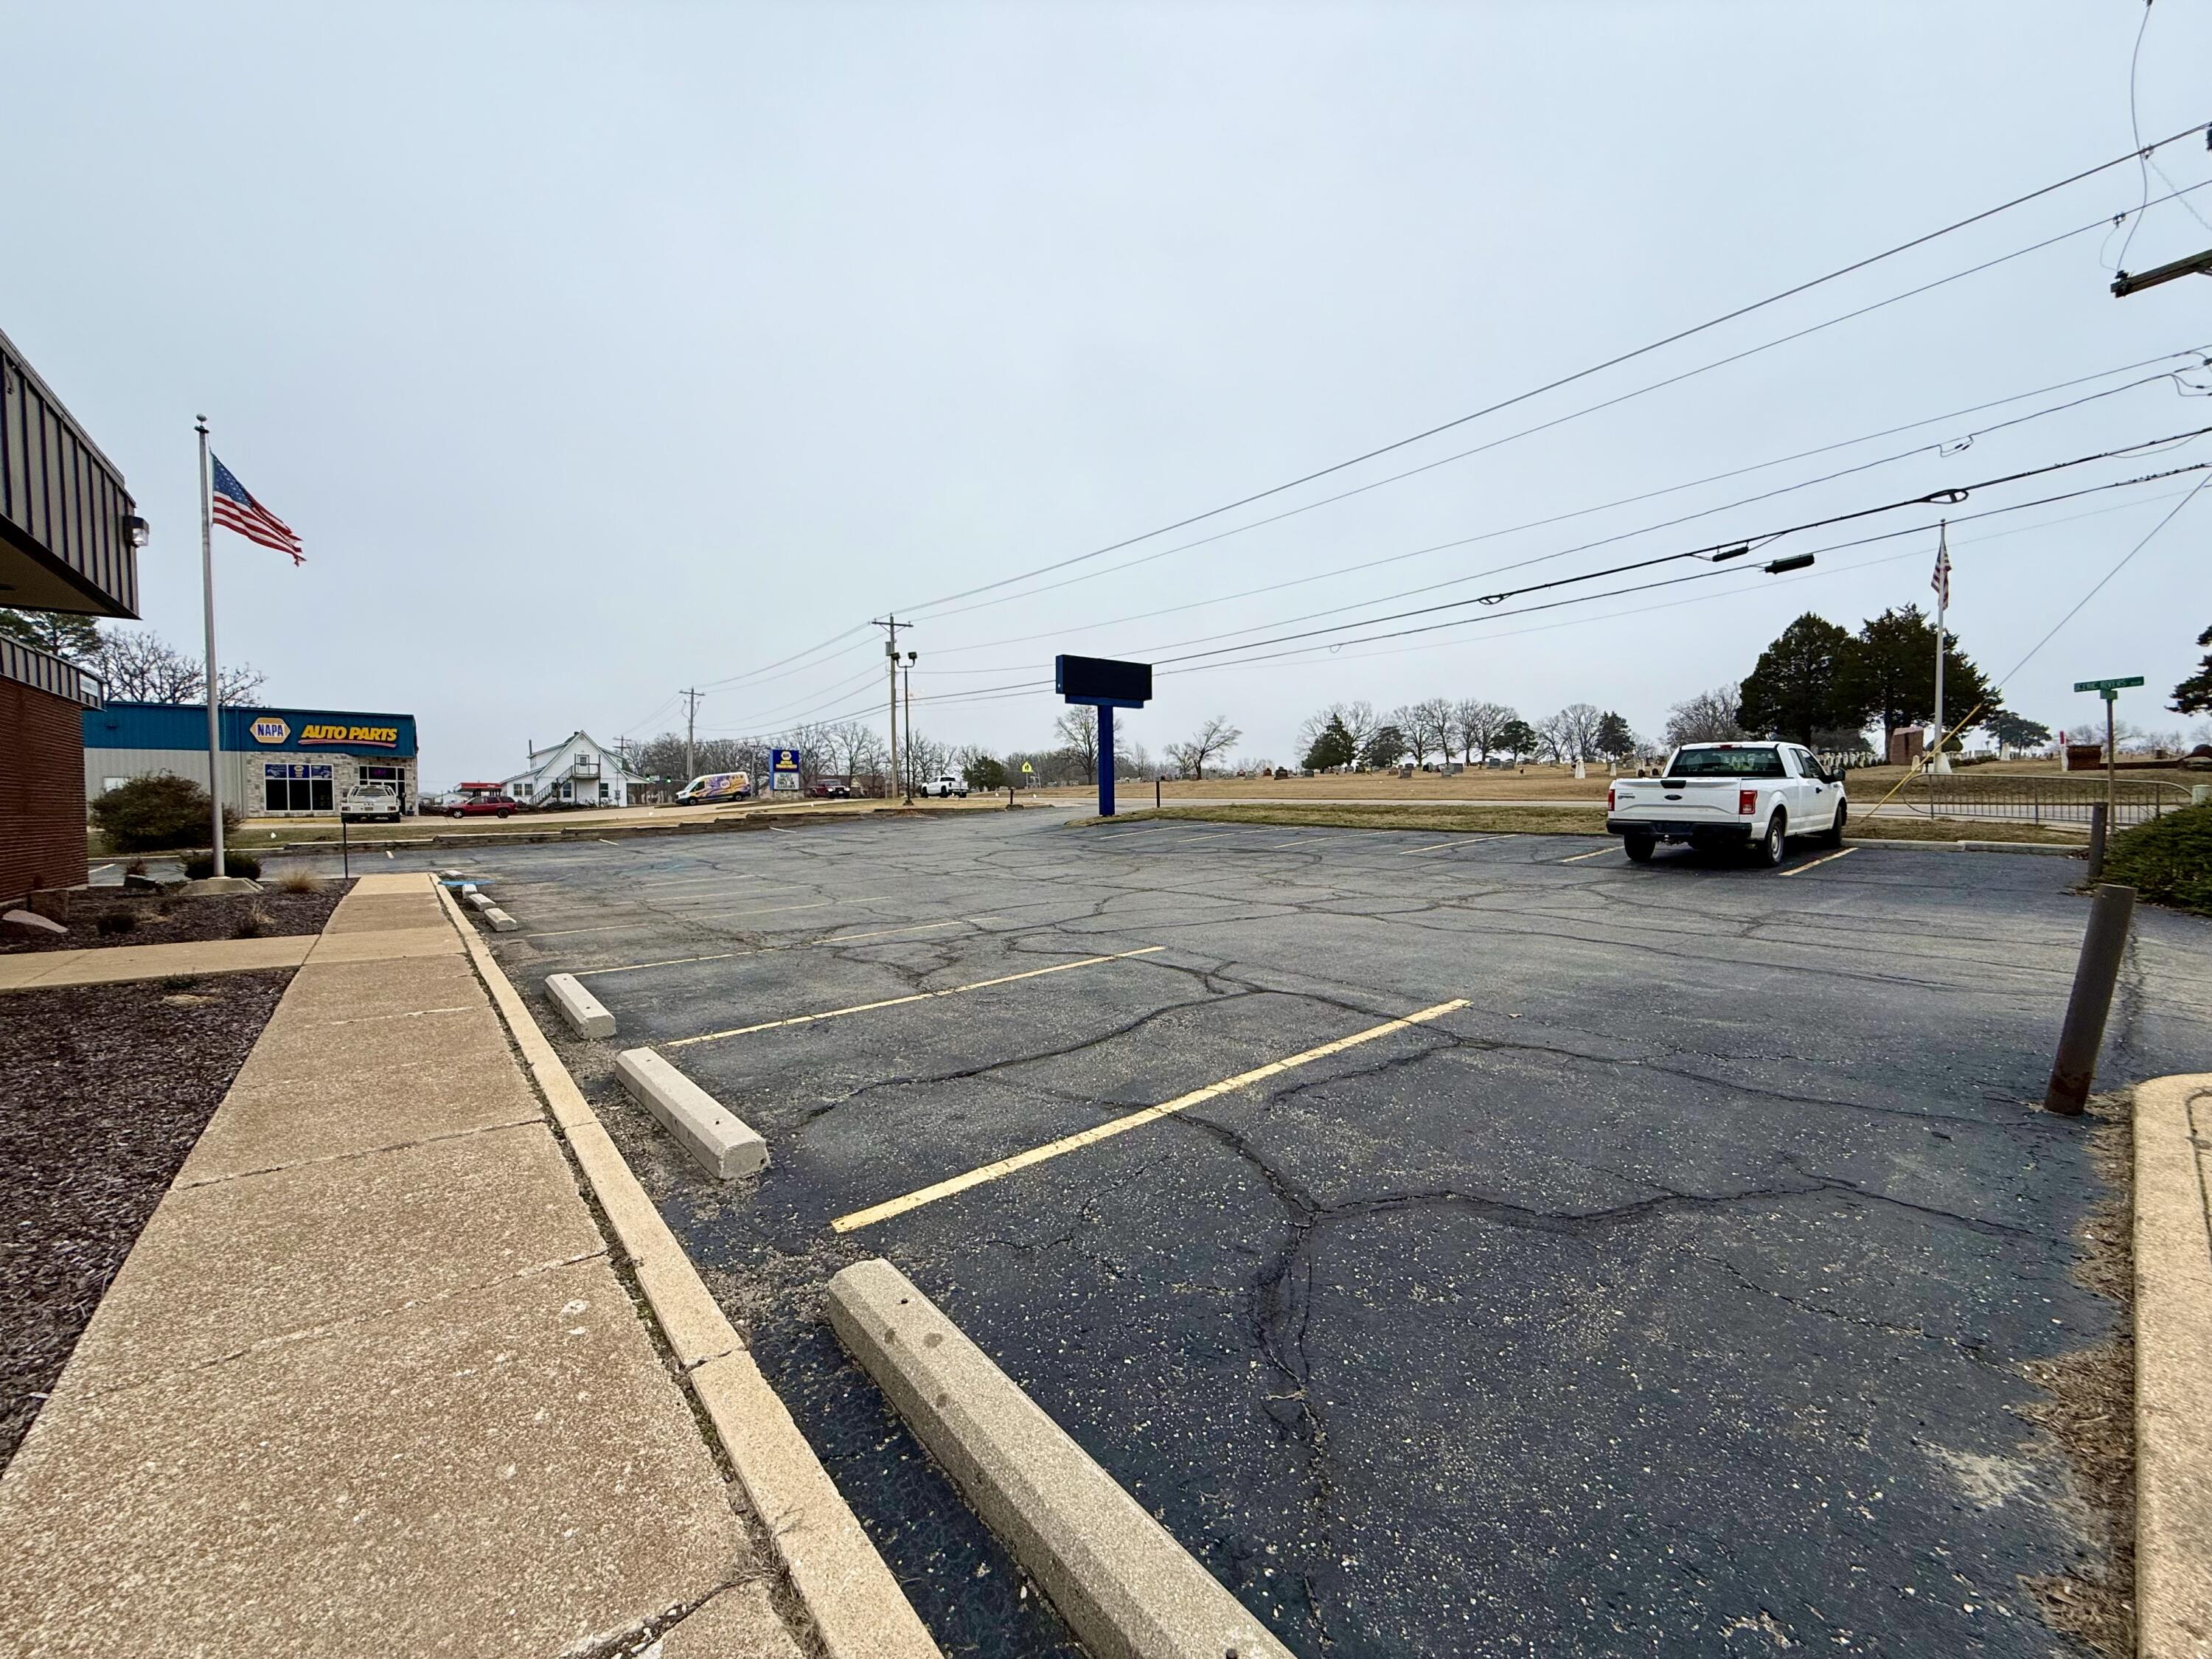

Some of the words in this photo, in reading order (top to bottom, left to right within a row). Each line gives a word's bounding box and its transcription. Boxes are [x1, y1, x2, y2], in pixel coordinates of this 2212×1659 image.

[257, 724, 284, 737] NAPA
[301, 725, 347, 740] AUTO
[348, 726, 397, 741] PARTS
